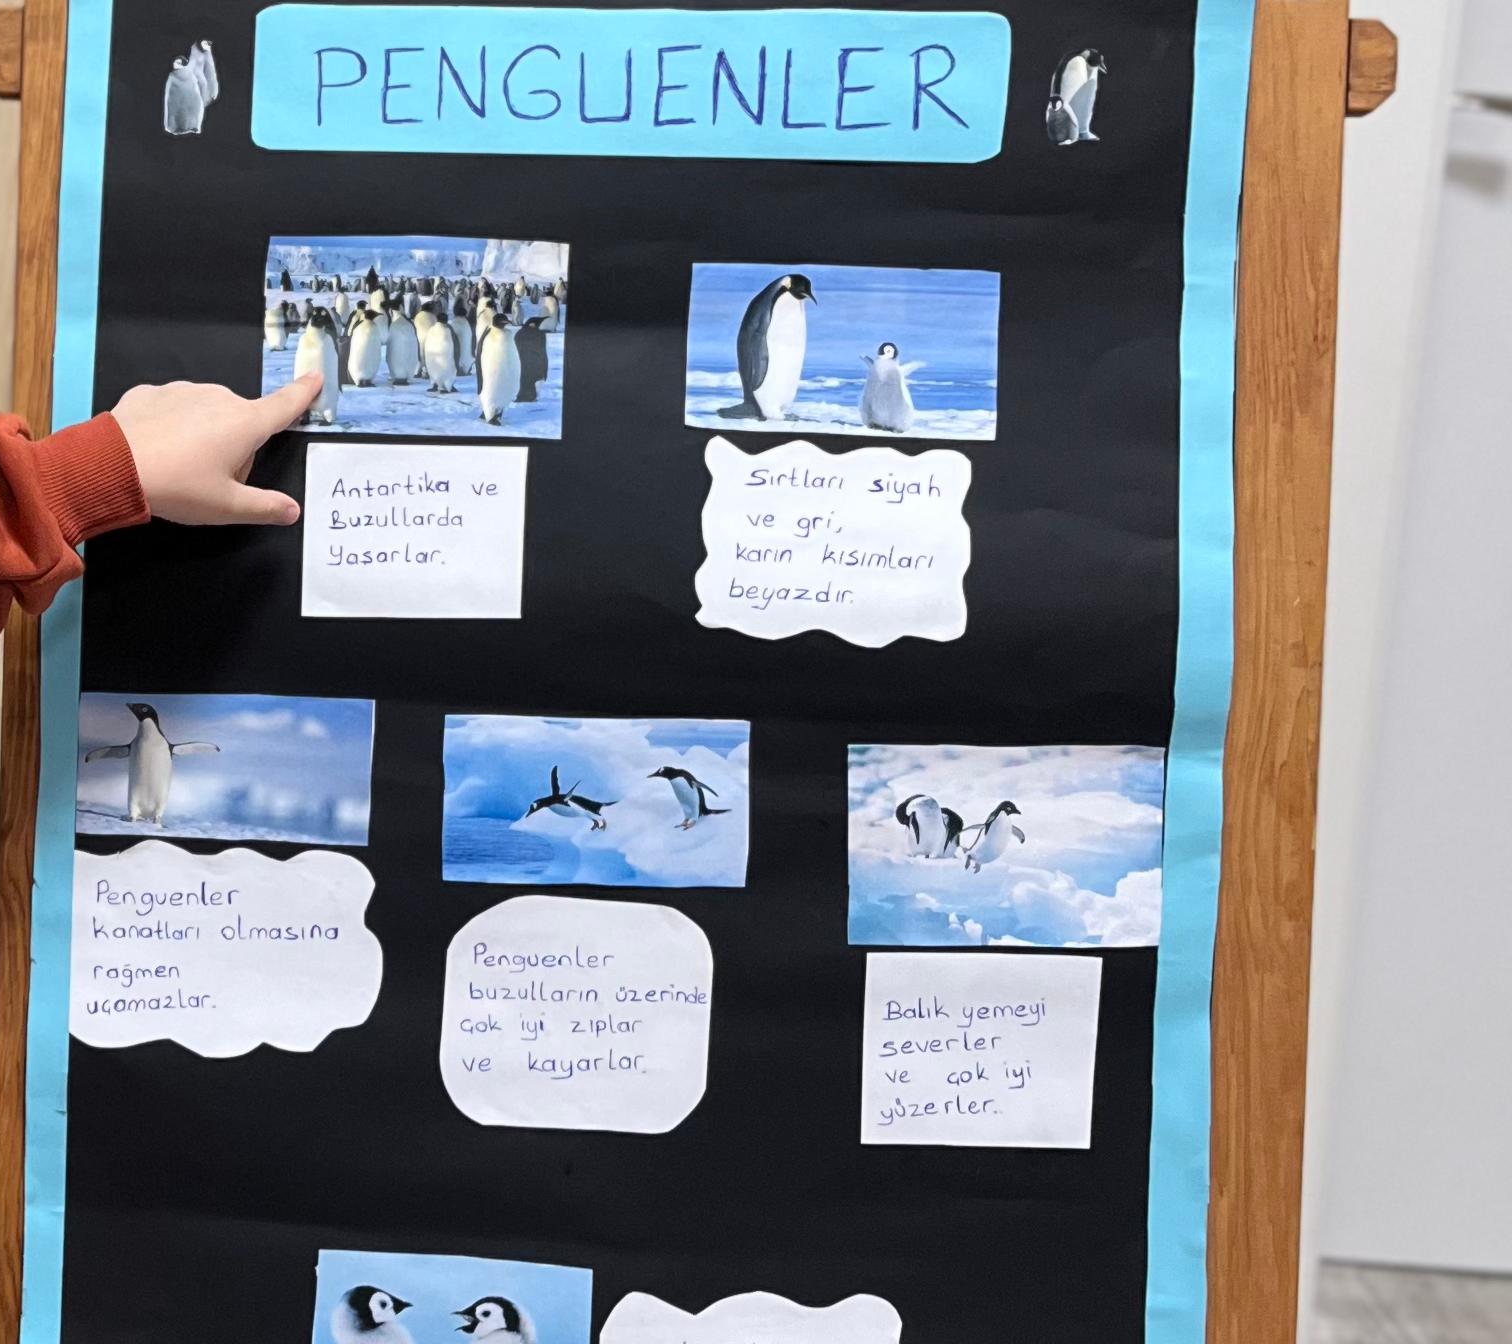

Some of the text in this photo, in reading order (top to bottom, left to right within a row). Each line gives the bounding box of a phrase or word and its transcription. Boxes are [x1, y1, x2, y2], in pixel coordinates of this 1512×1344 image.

[312, 44, 969, 130] PENGUENLER
[331, 472, 499, 499] Antartika ve
[744, 467, 941, 504] Sırtları siyah
[328, 506, 464, 529] Buzullarda
[746, 510, 842, 538] ve gri,
[822, 544, 934, 570] kısımları
[728, 577, 854, 610] beyazdır.
[97, 879, 240, 916] Penguenler
[221, 914, 338, 941] olmasına
[473, 942, 615, 973] Penguenler
[93, 963, 180, 988] rağmen
[86, 988, 217, 1015] uçamazlar.
[469, 981, 708, 1005] buzulların üzerinde
[883, 996, 1046, 1028] Balık yemeyi
[520, 1012, 546, 1041] iyi
[570, 1014, 643, 1037] zıplar
[879, 1031, 1002, 1057] severler
[461, 1057, 492, 1072] ve
[885, 1069, 911, 1083] ve
[1003, 1059, 1032, 1089] iyi
[877, 1095, 998, 1126] yüzerler.
